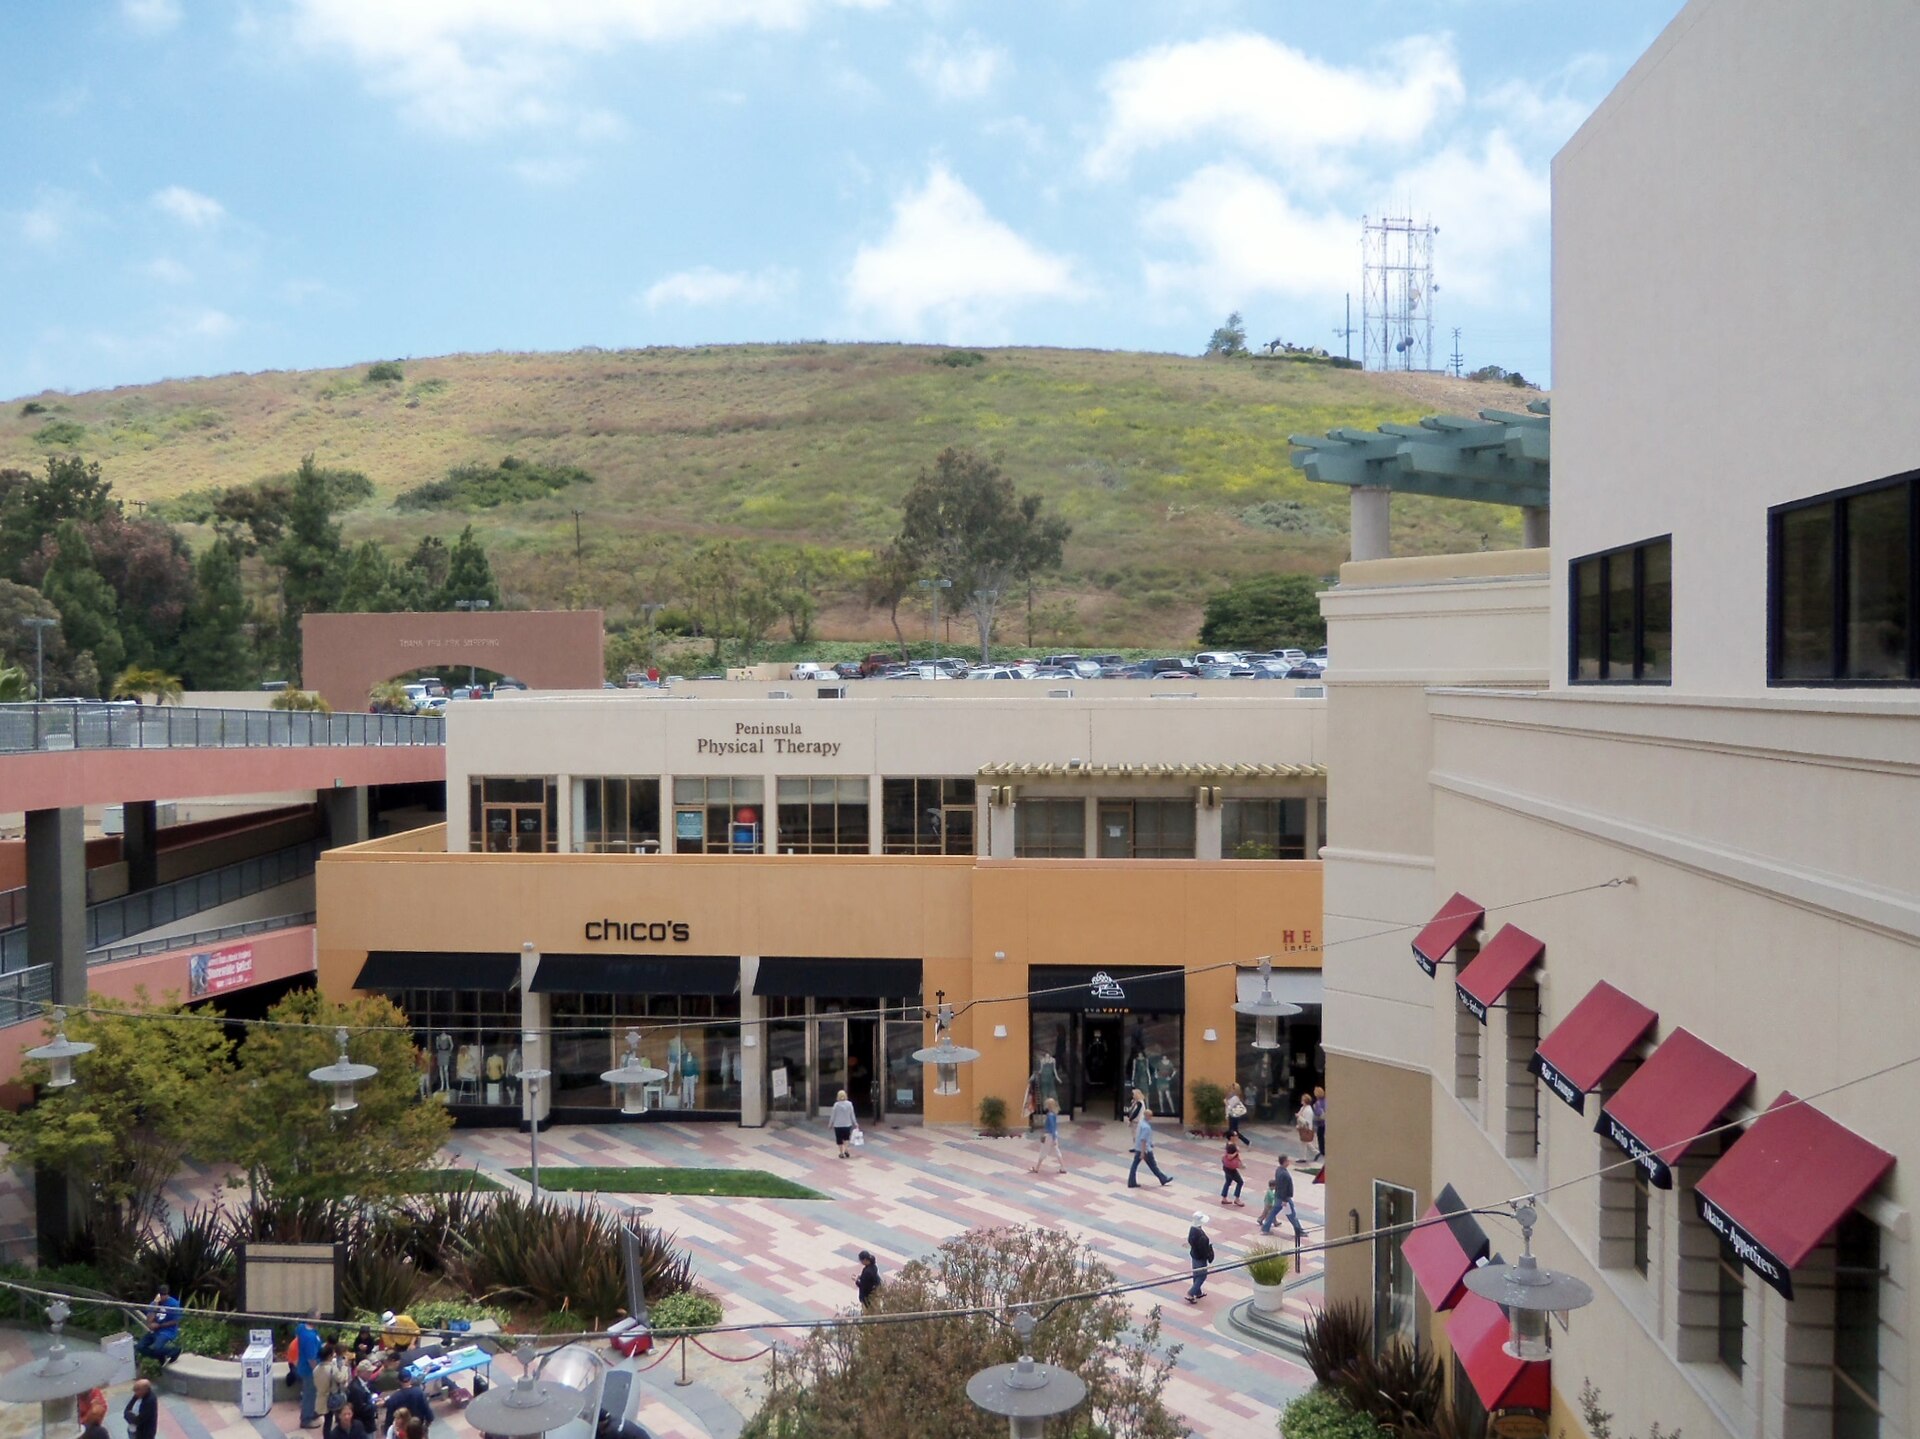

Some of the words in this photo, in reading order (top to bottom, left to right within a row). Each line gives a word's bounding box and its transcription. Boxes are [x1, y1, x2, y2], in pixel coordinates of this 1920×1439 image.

[735, 722, 802, 735] Peninsula
[697, 738, 764, 756] Physical
[773, 739, 841, 757] Therapy
[585, 918, 690, 941] chico's
